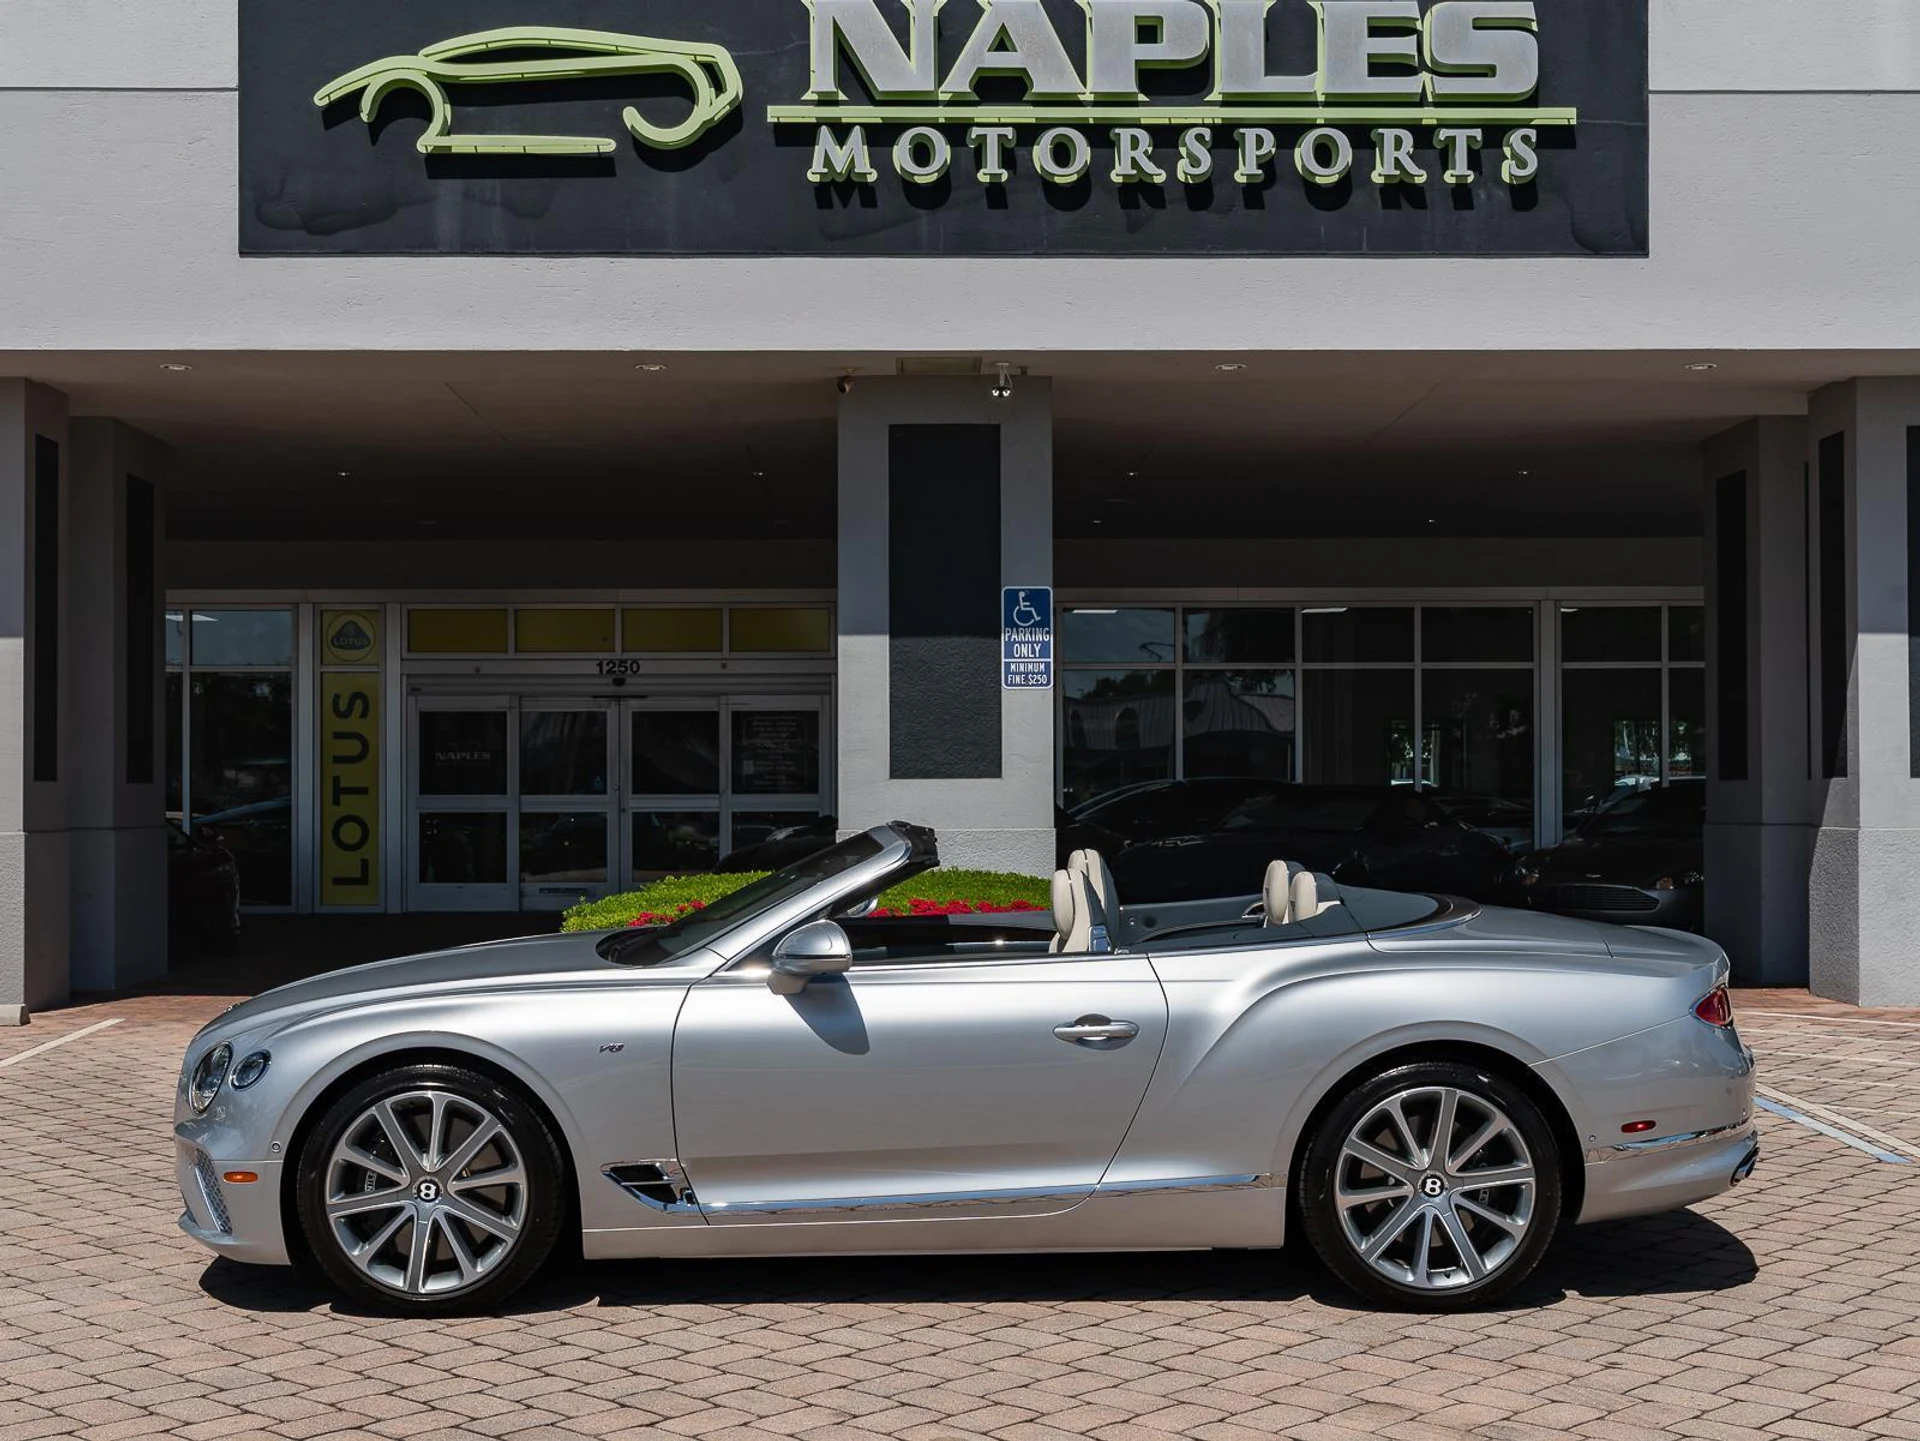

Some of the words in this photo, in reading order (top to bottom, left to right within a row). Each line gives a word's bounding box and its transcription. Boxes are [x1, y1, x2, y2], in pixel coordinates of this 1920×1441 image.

[801, 0, 1539, 100] NAPLES
[806, 125, 1538, 183] MOTORSPORTS
[333, 636, 369, 646] LOTUS
[1005, 628, 1050, 641] PARKING
[1013, 643, 1041, 658] ONLY
[596, 660, 641, 675] 1250
[1010, 663, 1045, 673] MINIMUM
[1008, 674, 1026, 684] FINE
[1029, 674, 1048, 685] $250
[435, 750, 491, 760] NAPLES
[332, 690, 370, 886] LOTUS
